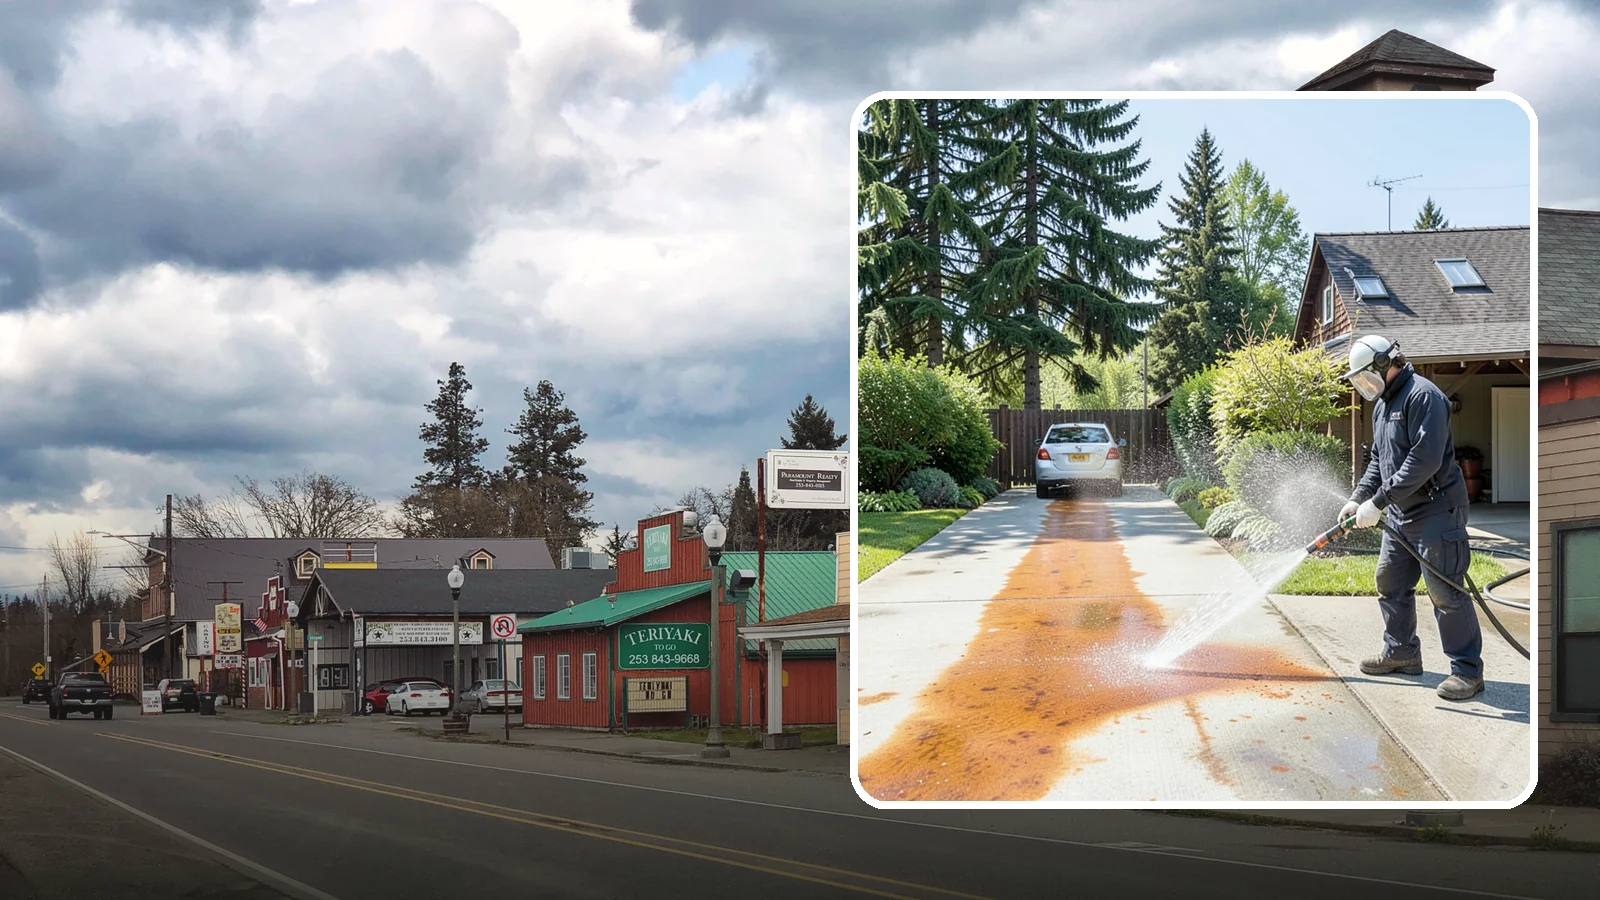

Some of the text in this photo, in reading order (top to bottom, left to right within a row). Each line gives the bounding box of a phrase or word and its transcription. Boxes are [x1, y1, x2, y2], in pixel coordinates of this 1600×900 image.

[624, 628, 702, 646] TERIYAKI
[629, 654, 700, 664] 253 843-9668
